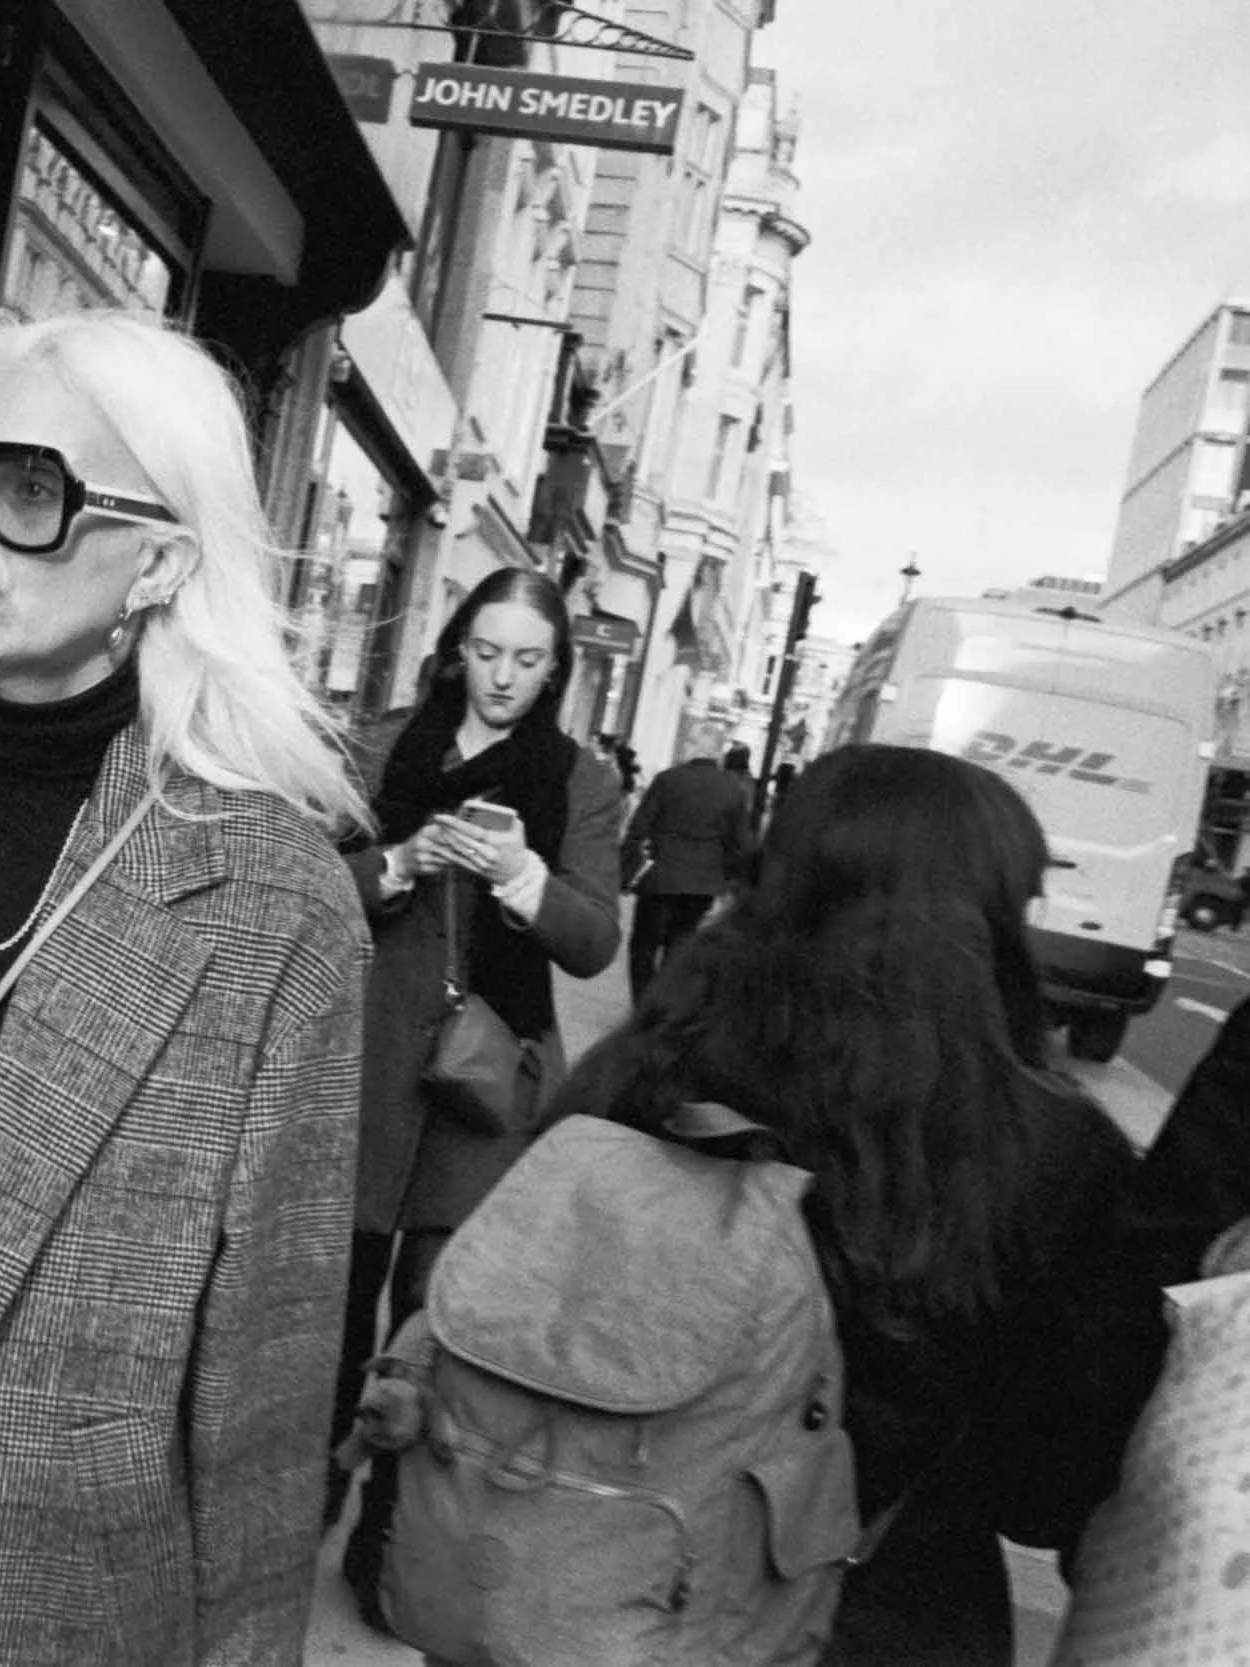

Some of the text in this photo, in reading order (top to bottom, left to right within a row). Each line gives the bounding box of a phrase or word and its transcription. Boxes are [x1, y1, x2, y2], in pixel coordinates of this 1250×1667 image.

[416, 77, 511, 112] JOHN
[518, 87, 677, 128] SMEDLEY
[964, 731, 1122, 786] DHL
